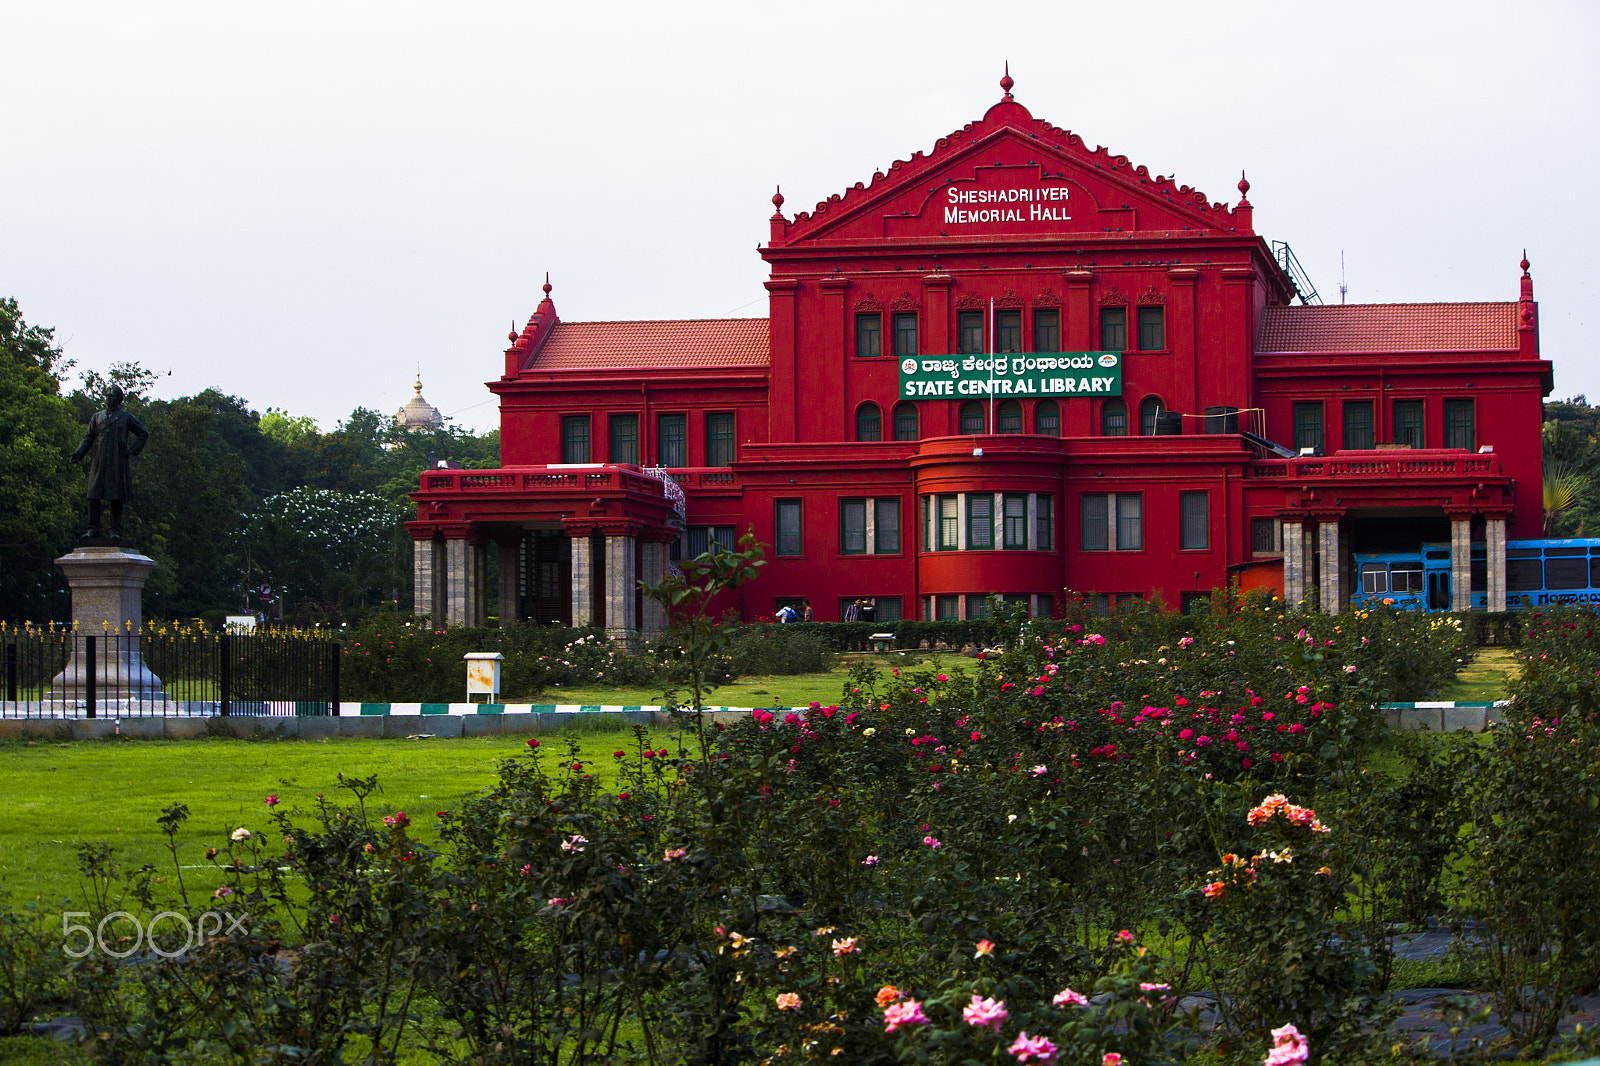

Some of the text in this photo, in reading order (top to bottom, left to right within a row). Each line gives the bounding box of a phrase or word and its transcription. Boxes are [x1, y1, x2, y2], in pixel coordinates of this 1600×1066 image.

[947, 187, 1069, 204] SHESHADRI IYER
[944, 203, 1072, 224] MEMORIAL HALL
[921, 353, 1094, 379] ರಾಜ್ಯ ಕೇಂದ್ರ ಗ್ರಂಥಾಲಯ
[905, 376, 1115, 396] STATE CENTRAL LIBRARY
